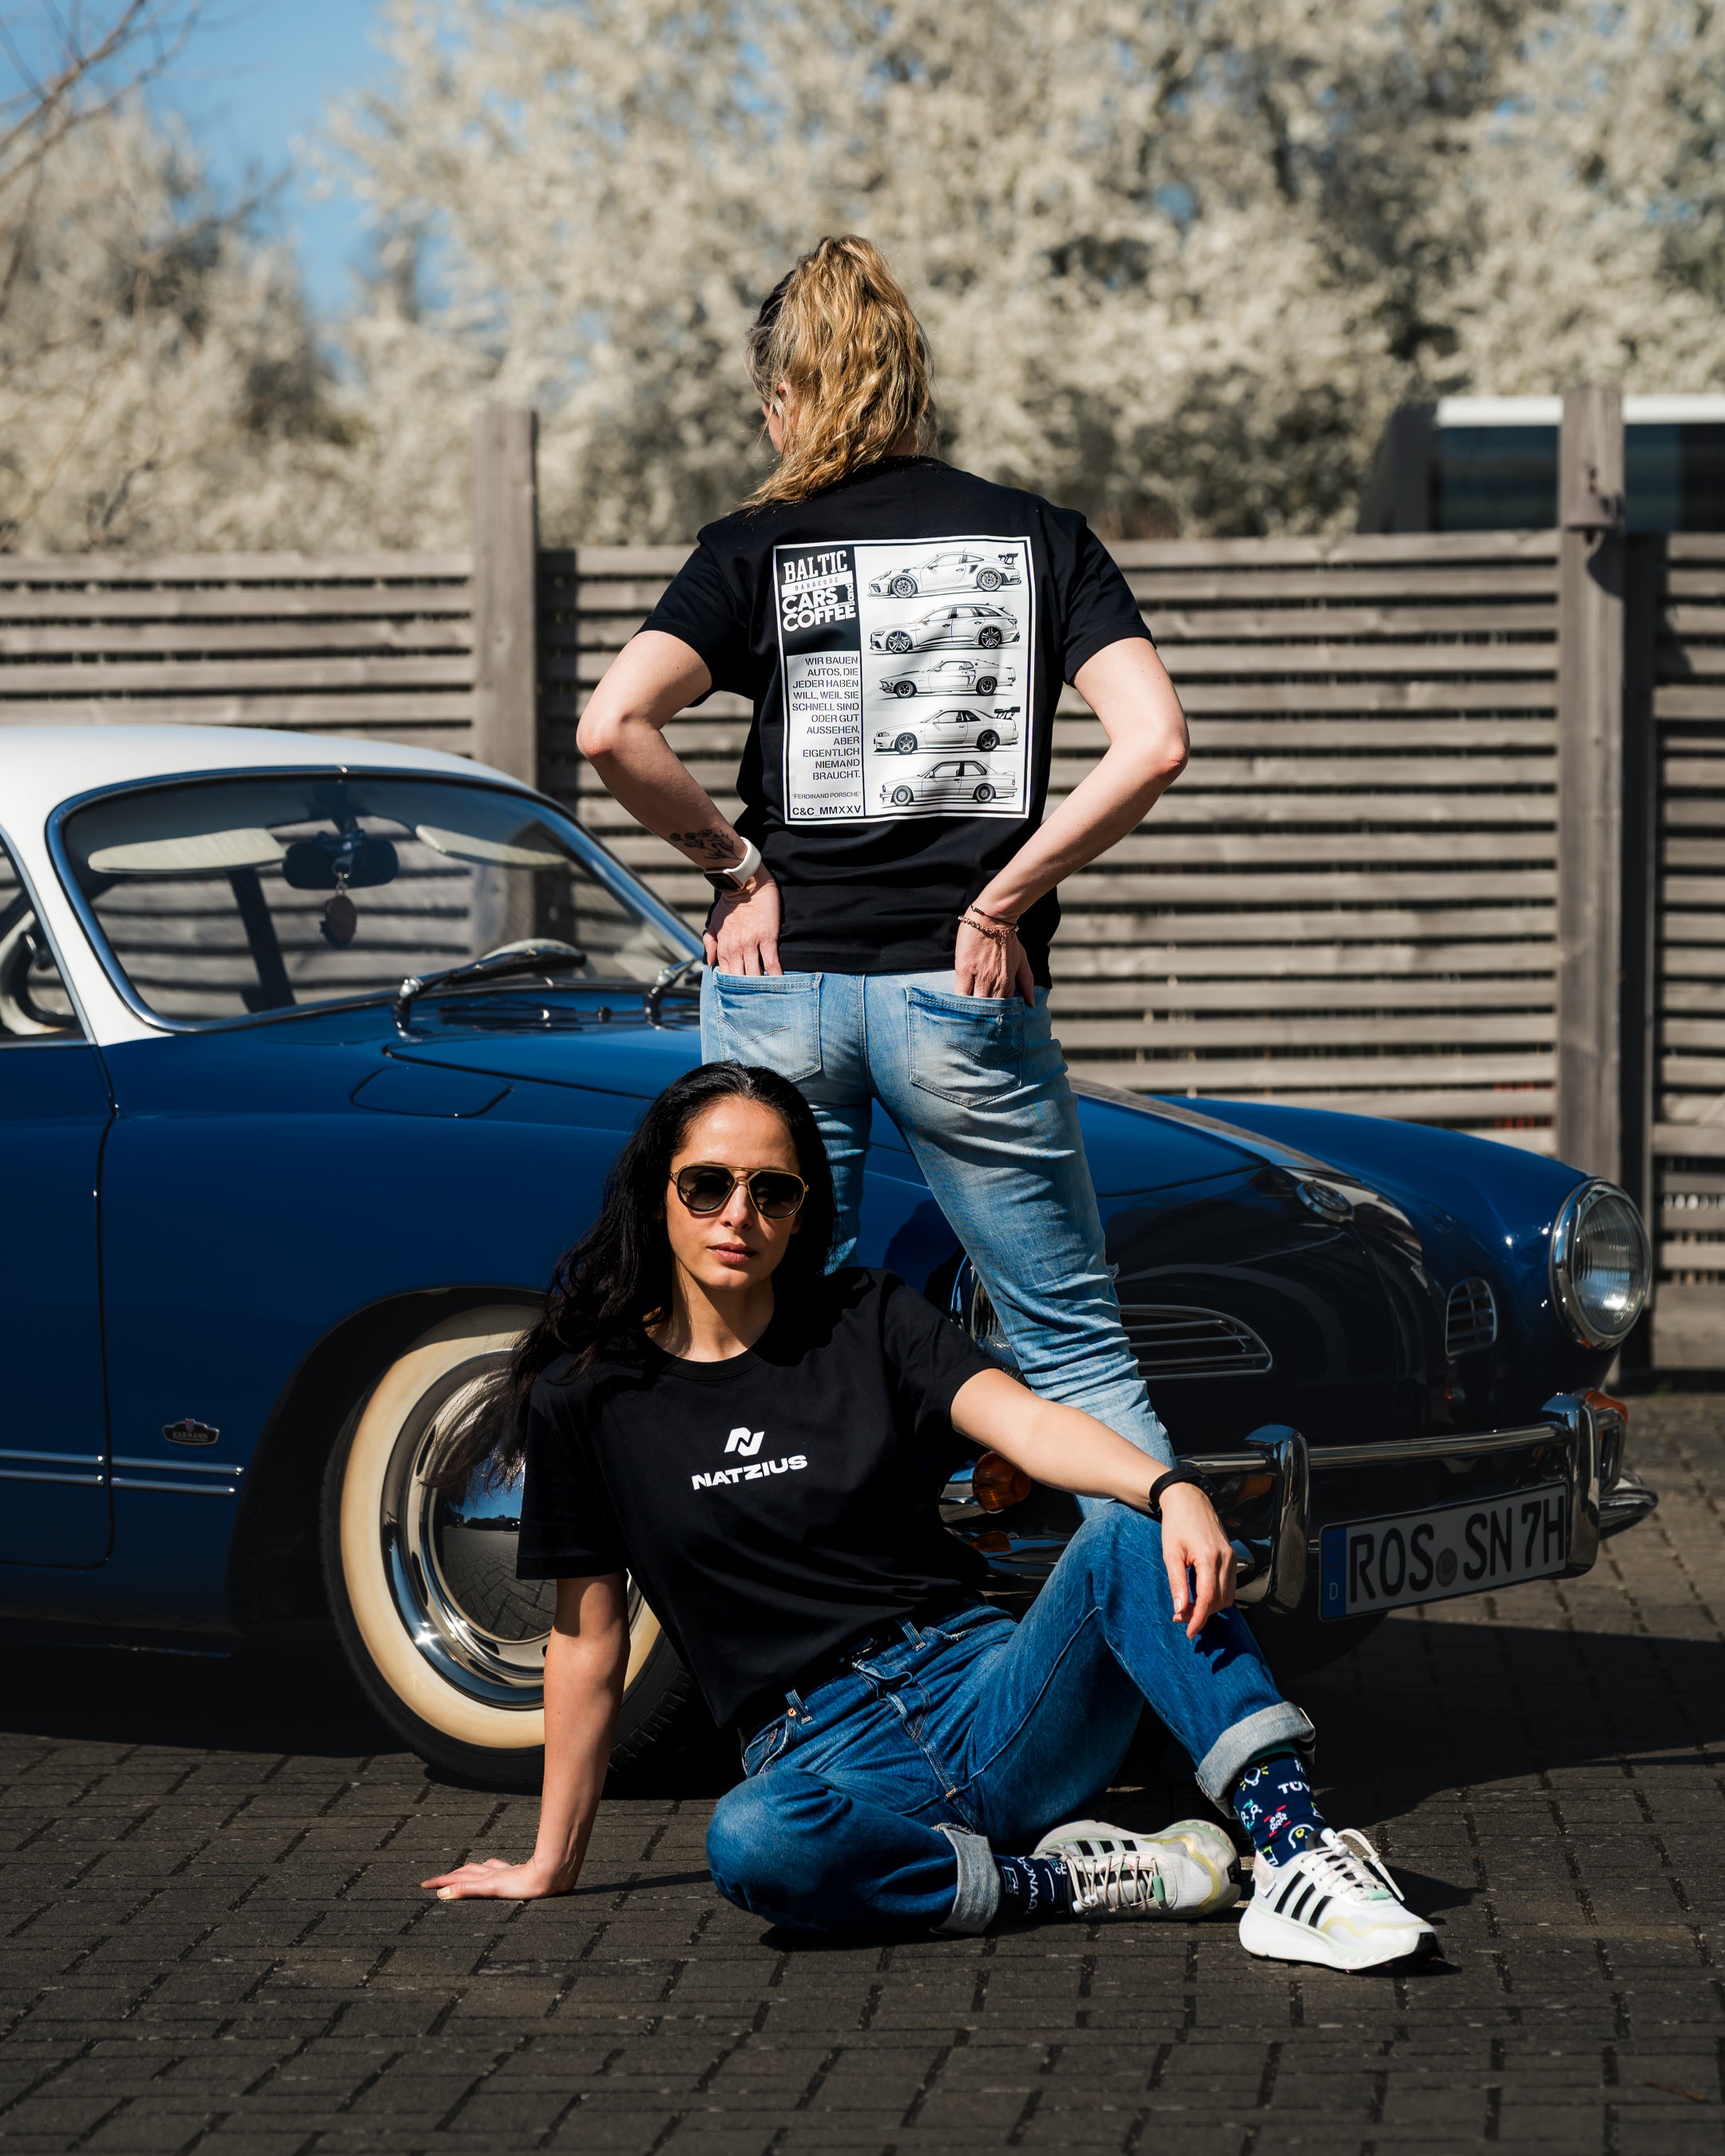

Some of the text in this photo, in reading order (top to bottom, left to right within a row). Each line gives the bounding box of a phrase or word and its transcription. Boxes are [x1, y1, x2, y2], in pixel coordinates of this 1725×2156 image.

[783, 550, 847, 584] BALTIC
[845, 583, 855, 601] and
[782, 586, 839, 614] CARS
[783, 601, 856, 632] COFFEE
[805, 656, 859, 666] WIR BAUEN
[807, 668, 842, 677] AUTOS,
[792, 680, 824, 688] JEDER
[793, 691, 859, 700] WILL, WEIL SIE
[792, 702, 859, 711] SCHNELL SIND
[811, 713, 859, 723] ODER GUT
[806, 725, 861, 735] AUSSEHEN,
[833, 736, 860, 746] ABER
[803, 747, 860, 758] EIGENTLICH
[815, 759, 860, 769] NIEMAND
[813, 770, 861, 780] BRAUCHT.
[692, 1455, 808, 1491] NATZIUS
[1350, 1495, 1565, 1603] ROS SN 7H
[1329, 1583, 1338, 1601] D
